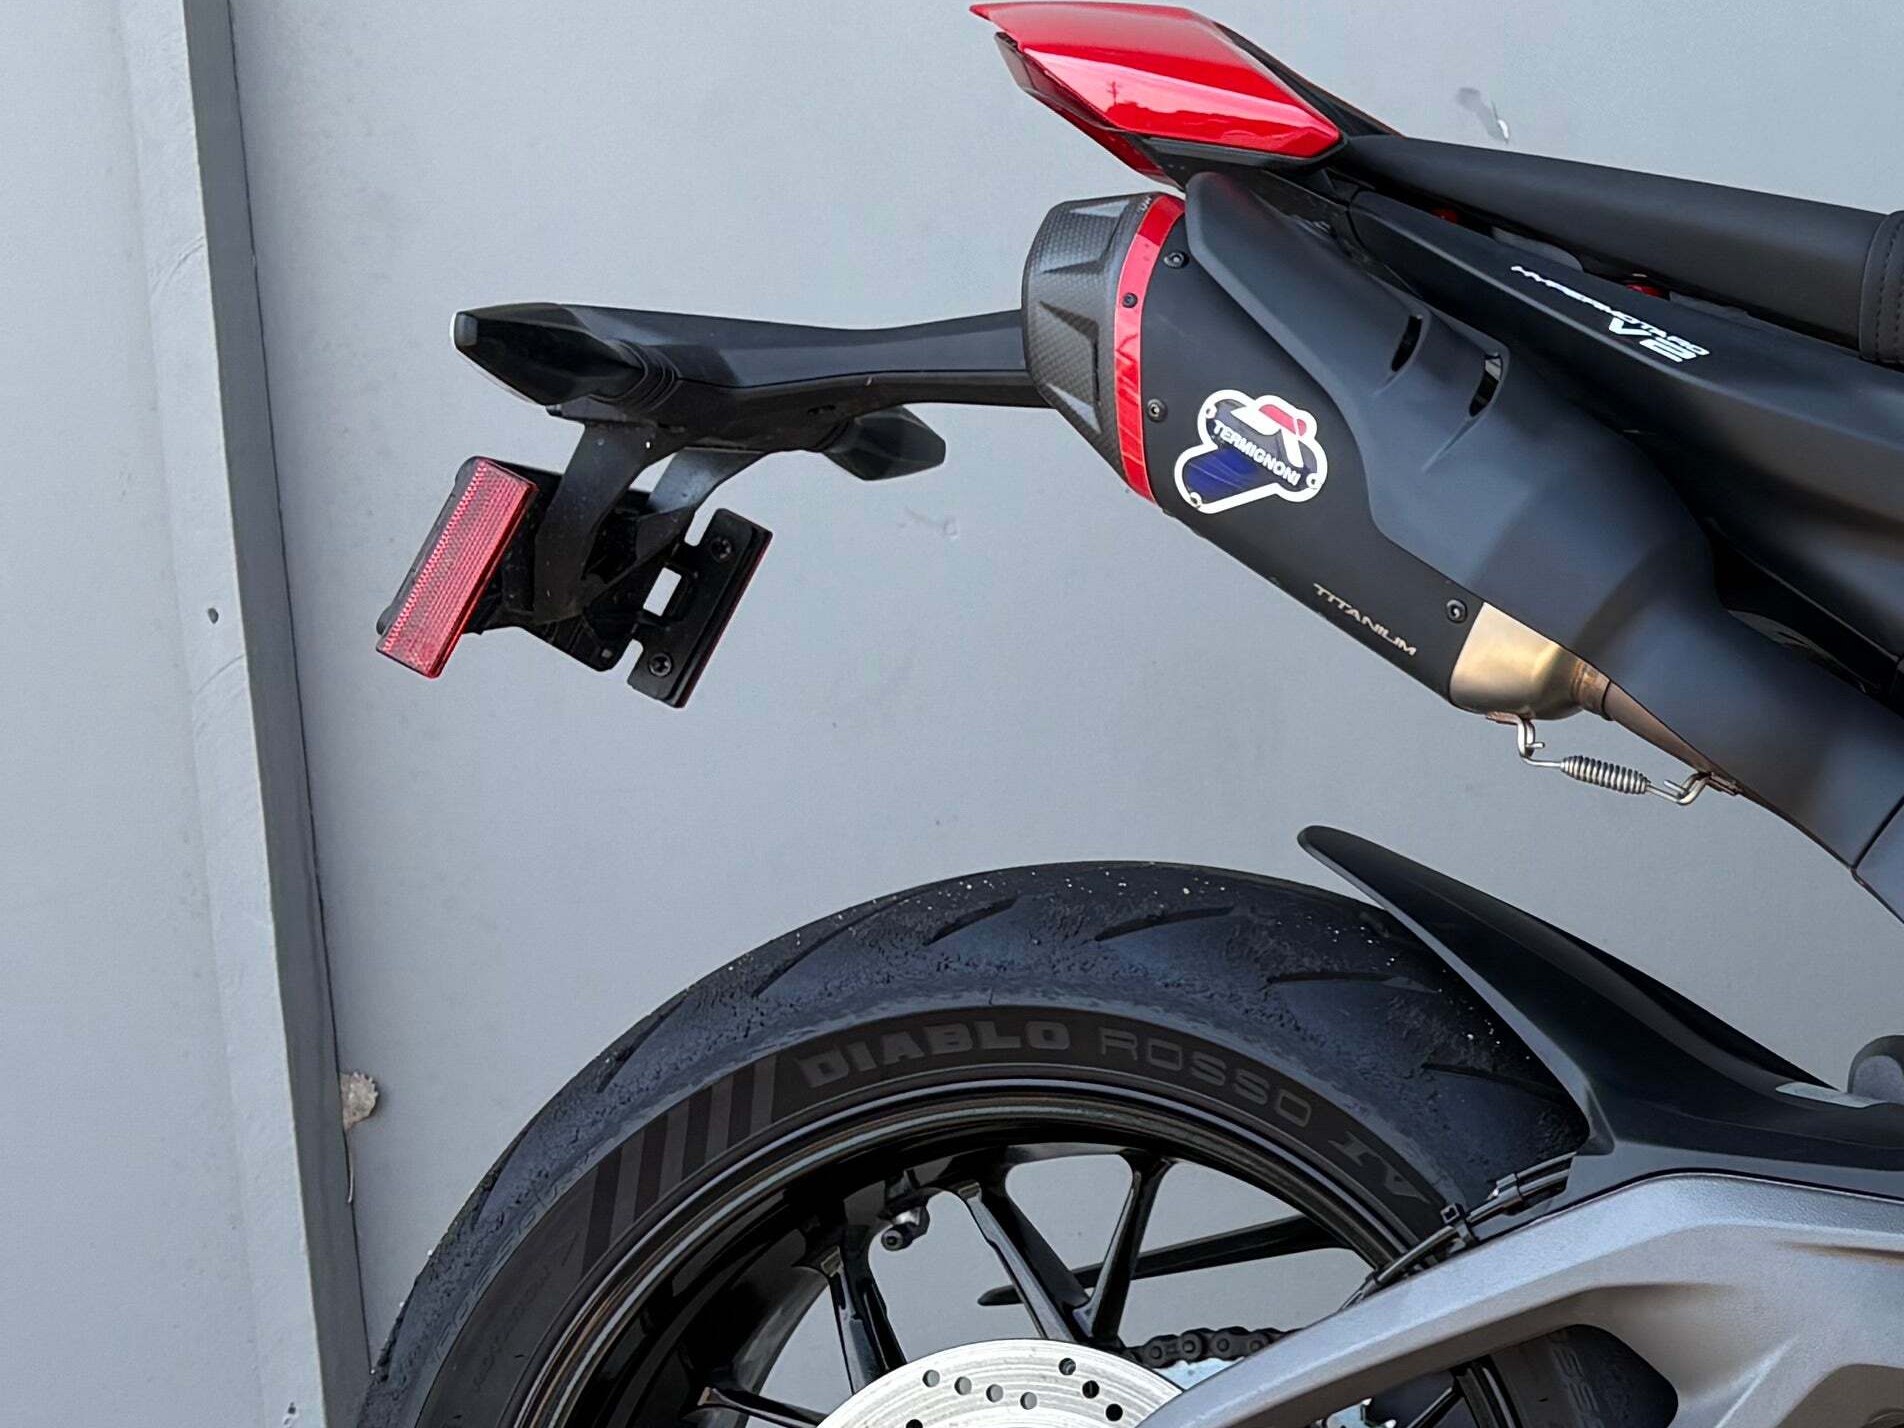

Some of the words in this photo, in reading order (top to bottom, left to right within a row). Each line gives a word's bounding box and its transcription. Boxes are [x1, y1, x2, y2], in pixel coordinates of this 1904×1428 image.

[1510, 265, 1710, 356] HYPERMOTARD
[1608, 317, 1697, 363] V2
[1213, 419, 1301, 486] TERMIGNONI
[1313, 582, 1417, 656] TITANIUM
[800, 1021, 1073, 1089] DIABLO
[1097, 1028, 1313, 1128] ROSSO
[1327, 1130, 1431, 1207] IV
